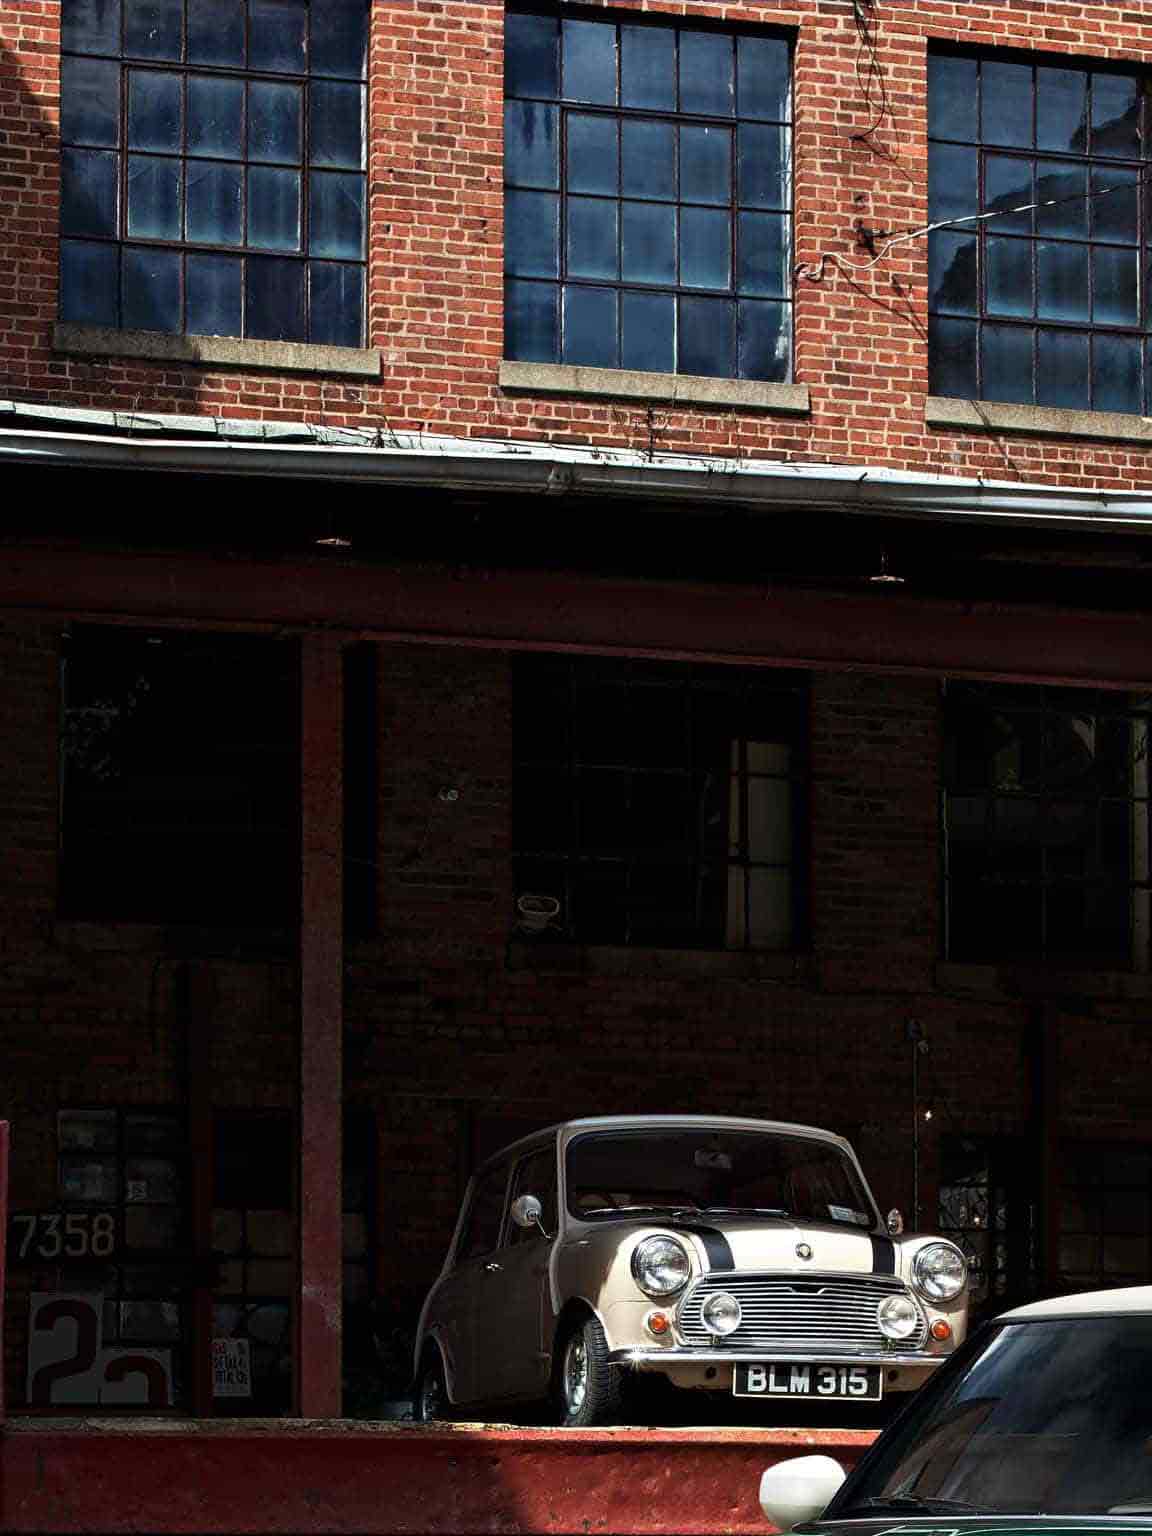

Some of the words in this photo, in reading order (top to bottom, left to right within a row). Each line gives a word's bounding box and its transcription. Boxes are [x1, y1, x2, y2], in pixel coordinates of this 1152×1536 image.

[13, 1213, 115, 1258] 7358
[747, 1365, 811, 1393] BLM
[816, 1366, 871, 1396] 315
